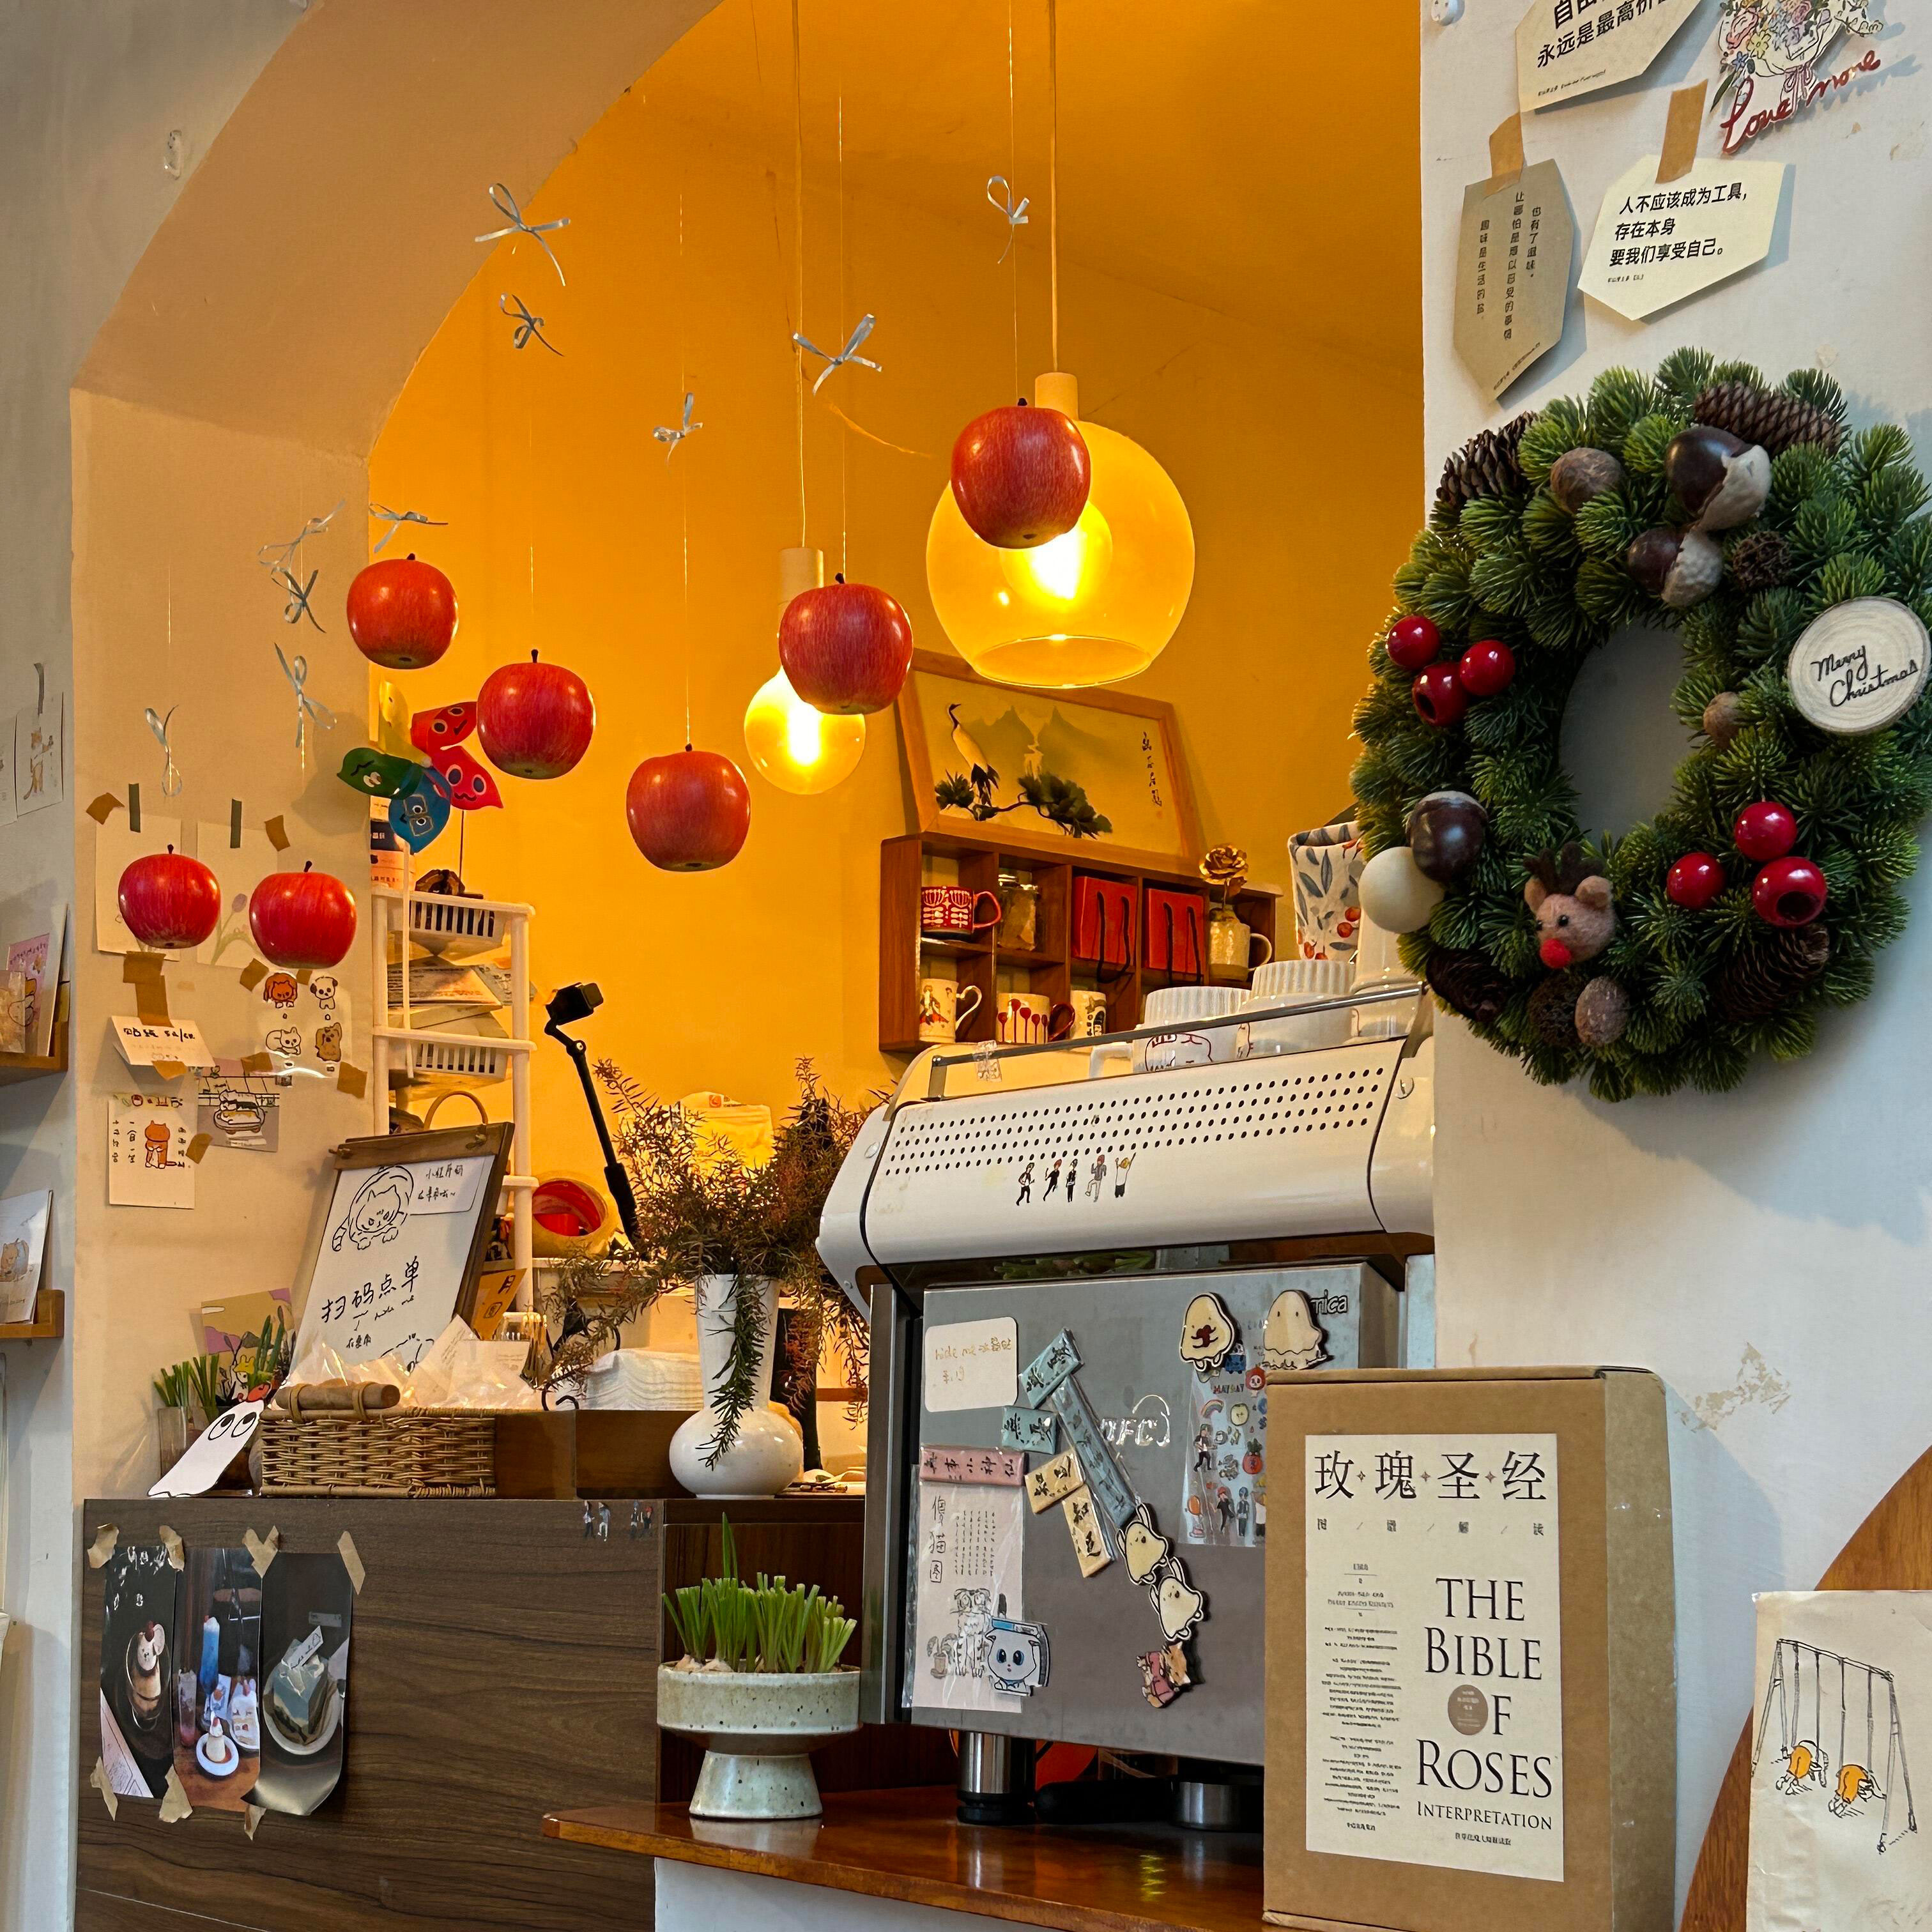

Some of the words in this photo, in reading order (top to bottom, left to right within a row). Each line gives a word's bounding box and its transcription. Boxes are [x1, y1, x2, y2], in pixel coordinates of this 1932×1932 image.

[1537, 0, 1666, 68] 永远是最高价
[1614, 217, 1676, 241] 存在本身
[1609, 238, 1723, 267] 要我们享受自己。
[1811, 645, 1869, 682] Merry
[1829, 659, 1919, 707] Christmas
[321, 1255, 419, 1323] 扫码点单
[1436, 1577, 1525, 1621] THE
[1423, 1626, 1542, 1681] BIBLE
[1416, 1738, 1552, 1798] ROSES
[1417, 1800, 1552, 1830] INTERPRETATION
